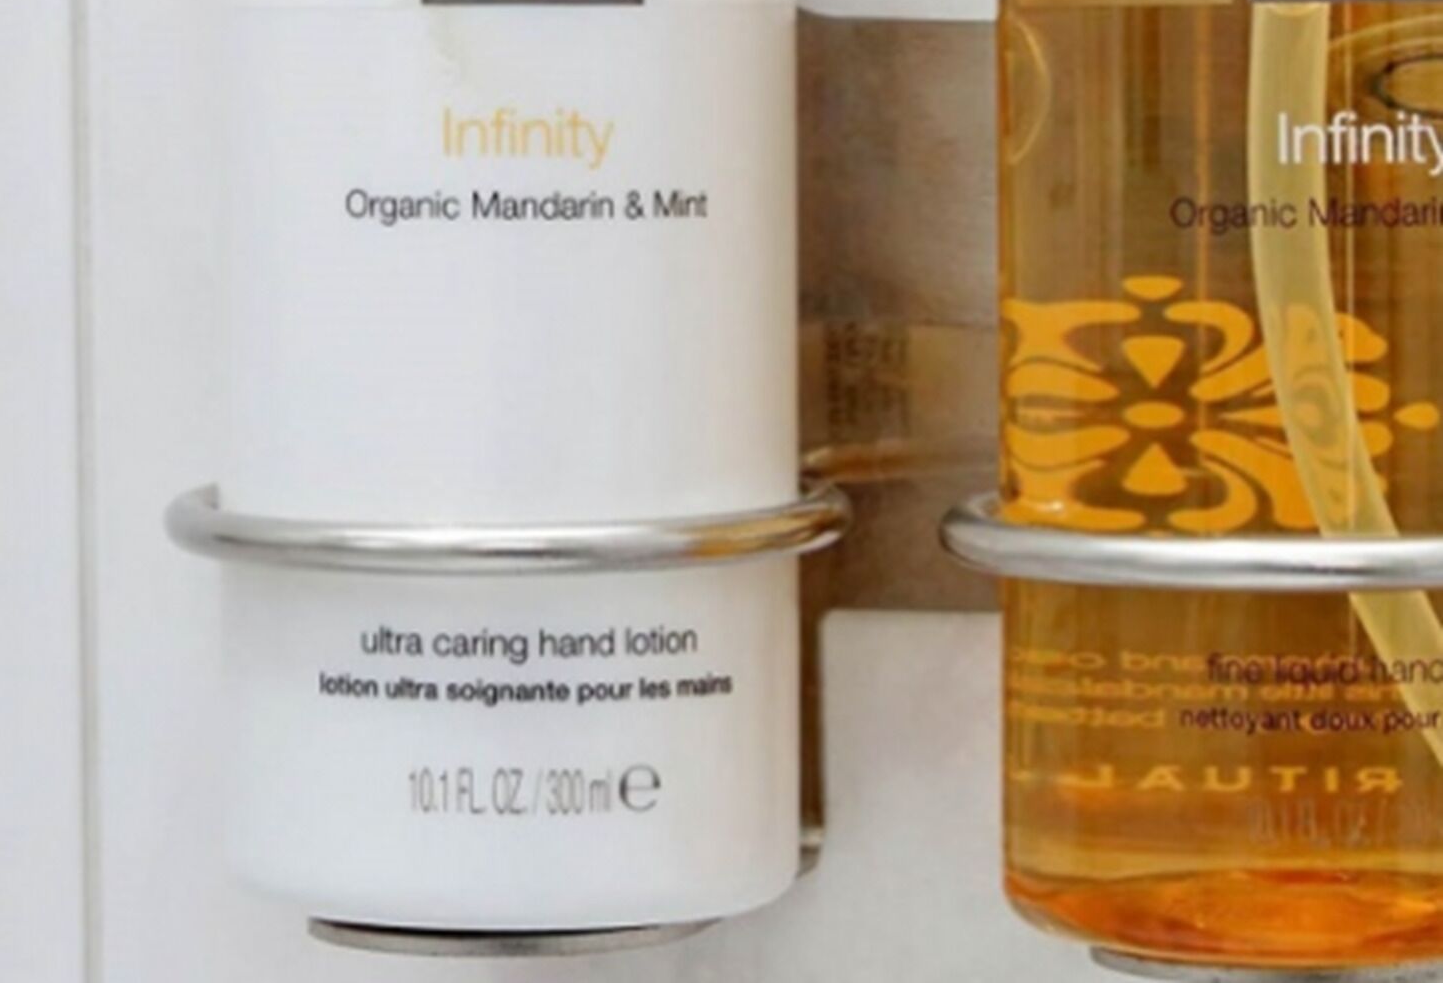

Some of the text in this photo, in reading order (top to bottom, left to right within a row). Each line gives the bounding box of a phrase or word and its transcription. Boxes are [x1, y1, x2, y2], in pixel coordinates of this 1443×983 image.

[443, 107, 615, 170] Infinity
[1277, 111, 1443, 176] Infinity
[345, 188, 708, 227] Organic Mandarin & Mint
[1169, 197, 1443, 235] Organic Mandari
[361, 625, 698, 665] ultra caring hand lotion
[1207, 651, 1263, 684] fine
[319, 672, 734, 707] lotion ultra soignante pour les mains
[1180, 707, 1300, 735] nettoyant
[1310, 709, 1374, 731] doux
[1382, 710, 1440, 734] pour
